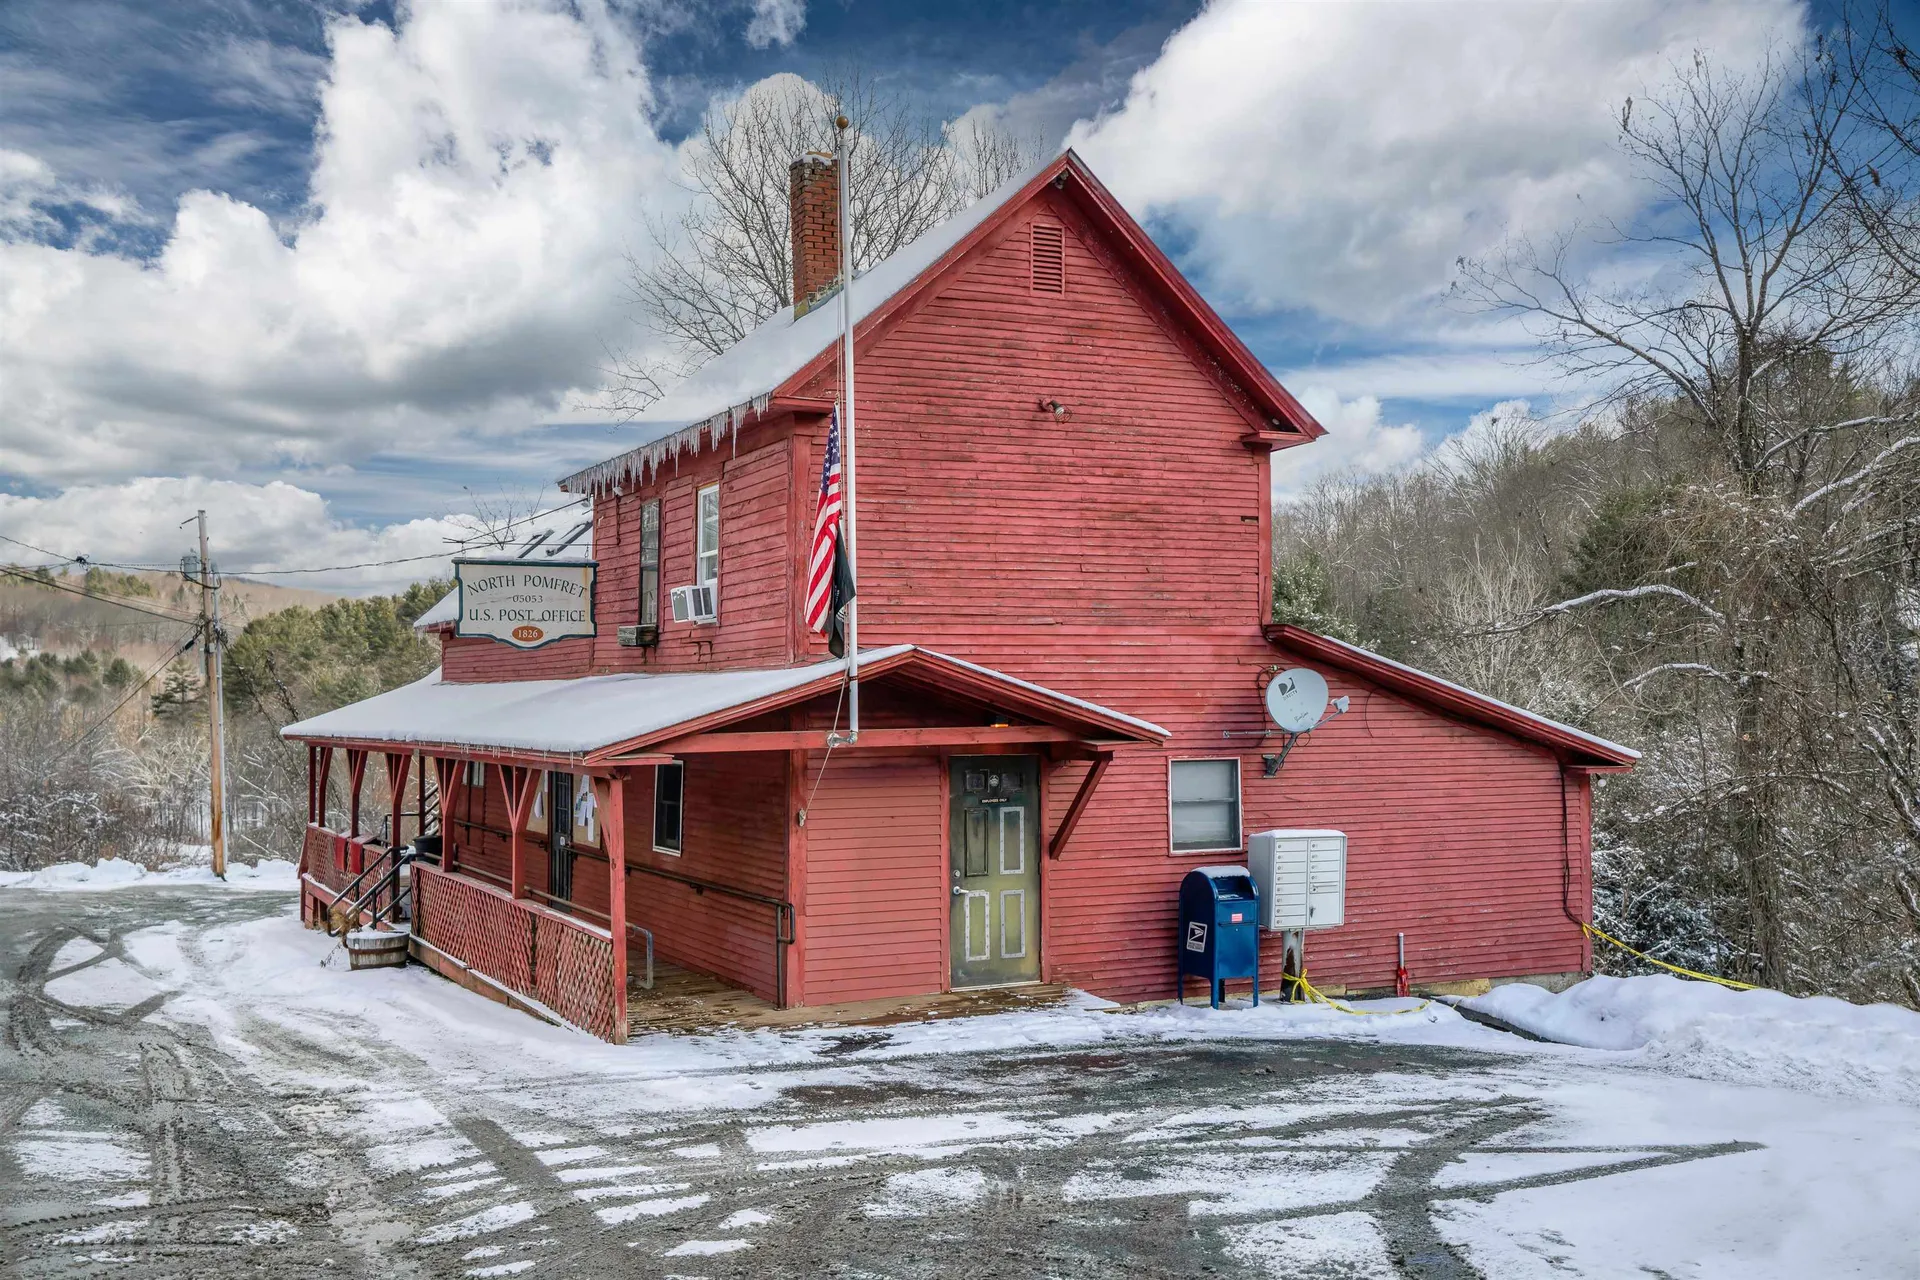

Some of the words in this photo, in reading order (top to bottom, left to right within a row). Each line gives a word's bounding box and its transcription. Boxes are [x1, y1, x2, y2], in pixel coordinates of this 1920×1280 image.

[467, 575, 515, 596] NORTH
[524, 575, 587, 598] POMFRET
[512, 595, 543, 603] 05053
[469, 608, 494, 621] U.S.
[499, 609, 533, 621] POST
[542, 609, 586, 622] OFFICE
[518, 630, 538, 638] 1826
